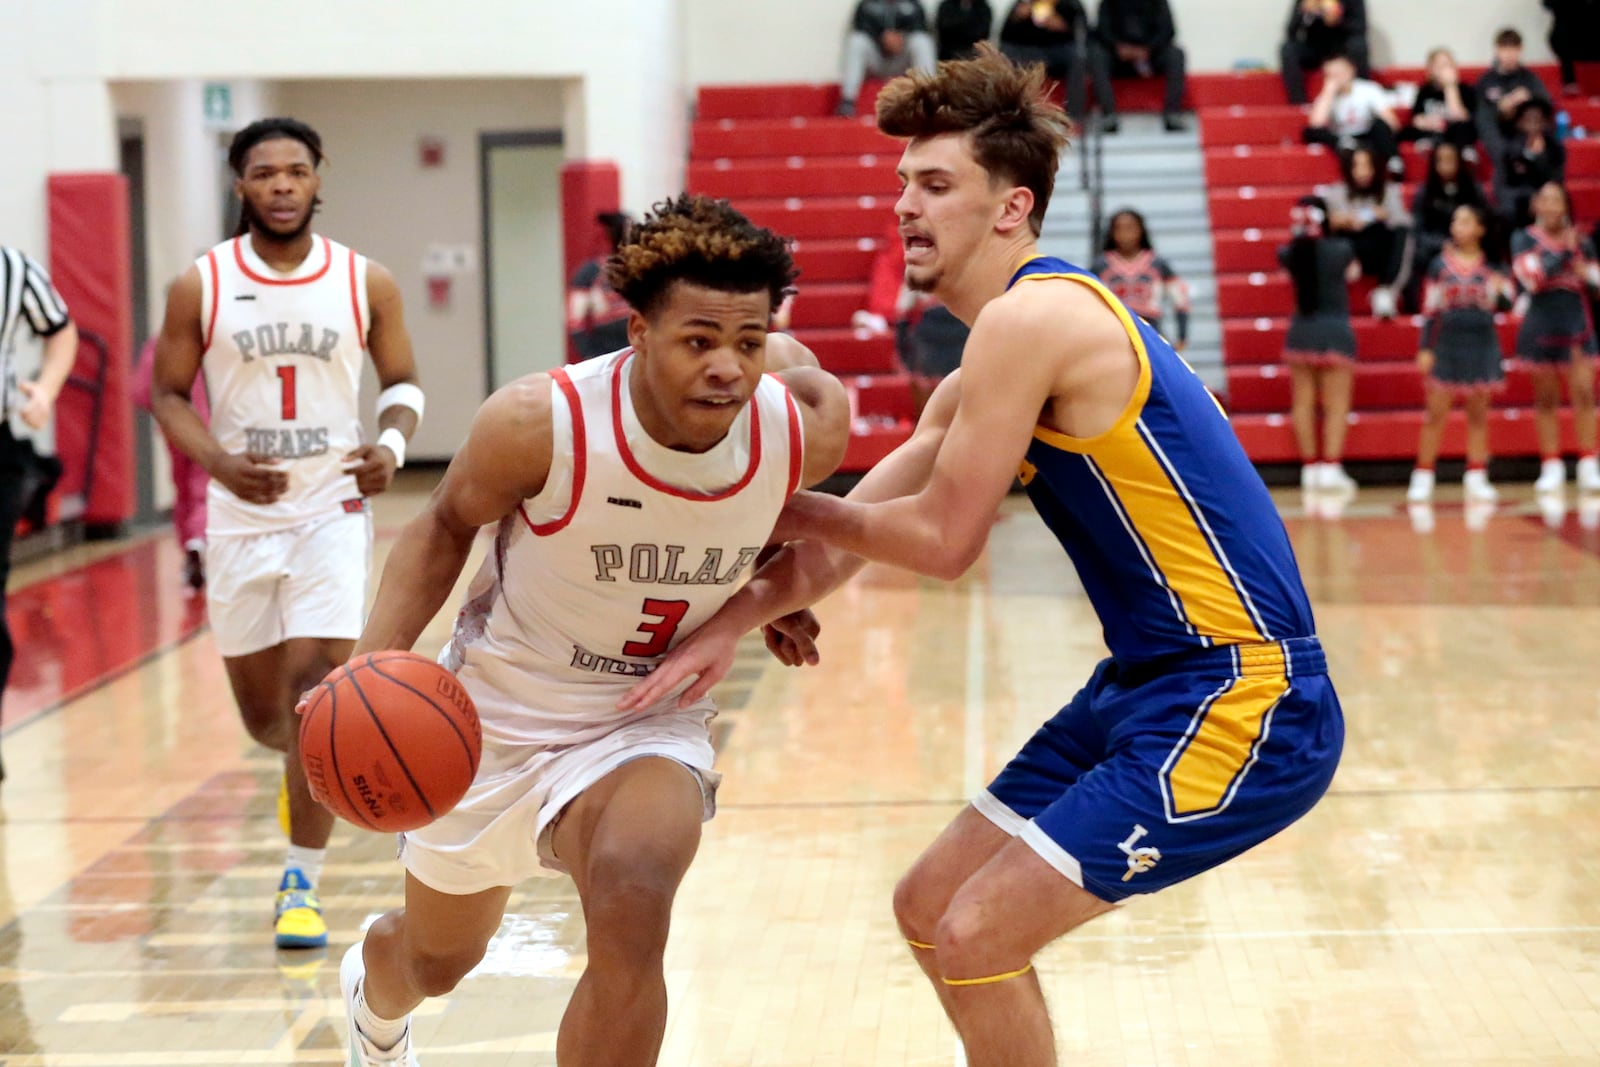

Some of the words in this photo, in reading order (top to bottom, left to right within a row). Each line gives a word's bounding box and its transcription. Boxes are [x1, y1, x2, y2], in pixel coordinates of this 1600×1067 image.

[232, 323, 340, 362] POLAR
[277, 365, 297, 421] 1
[590, 543, 761, 585] POLAR
[621, 597, 690, 659] 3
